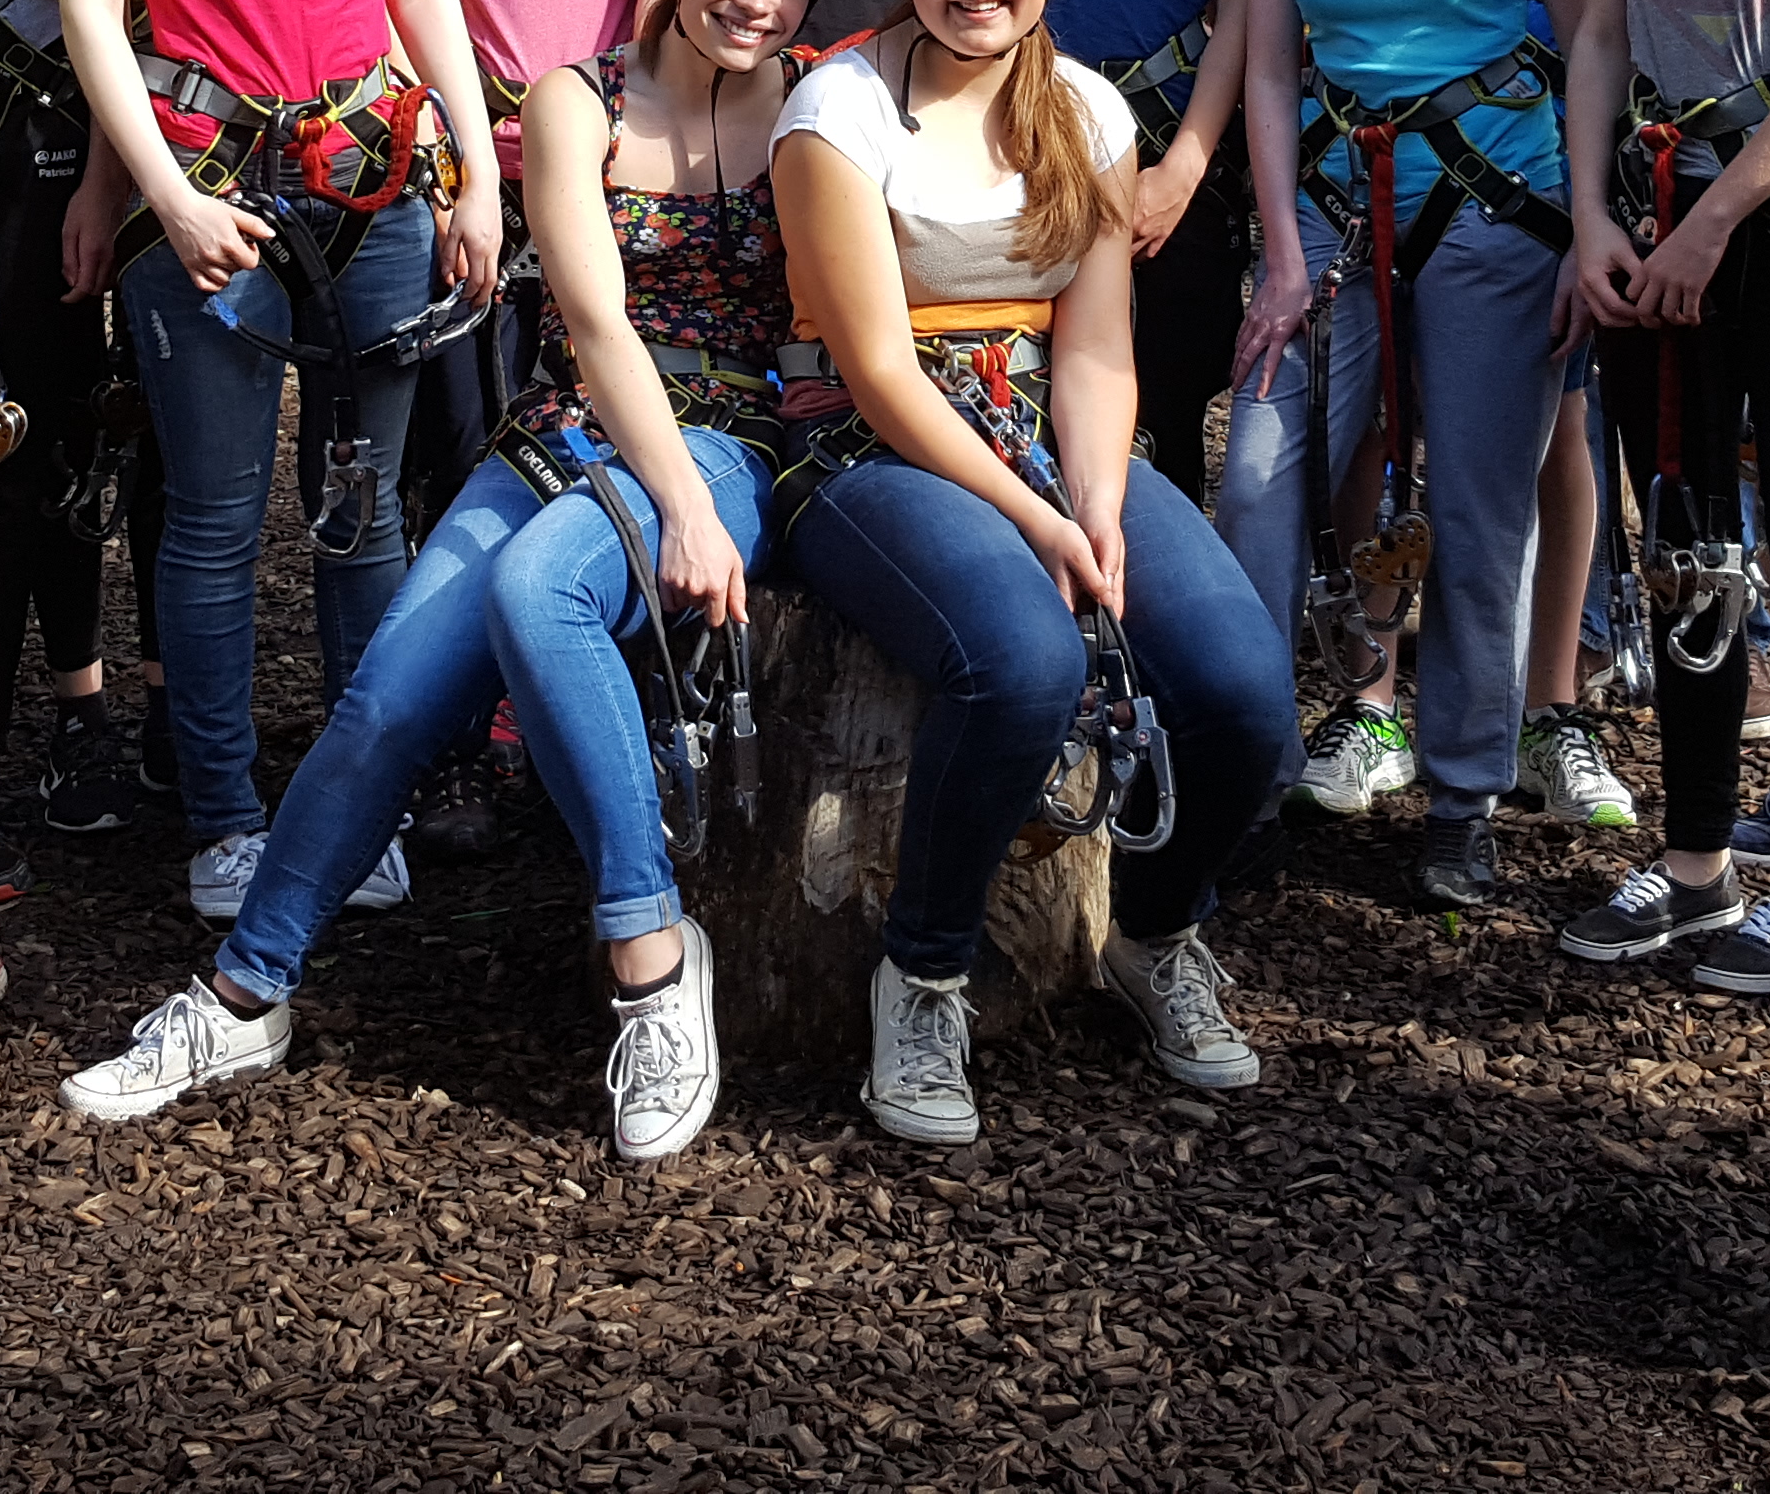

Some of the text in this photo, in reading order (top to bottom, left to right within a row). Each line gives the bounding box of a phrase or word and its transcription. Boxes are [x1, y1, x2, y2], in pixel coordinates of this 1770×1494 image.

[50, 149, 77, 162] JAKO
[38, 167, 76, 178] Patricia
[518, 445, 563, 492] EDELRID
